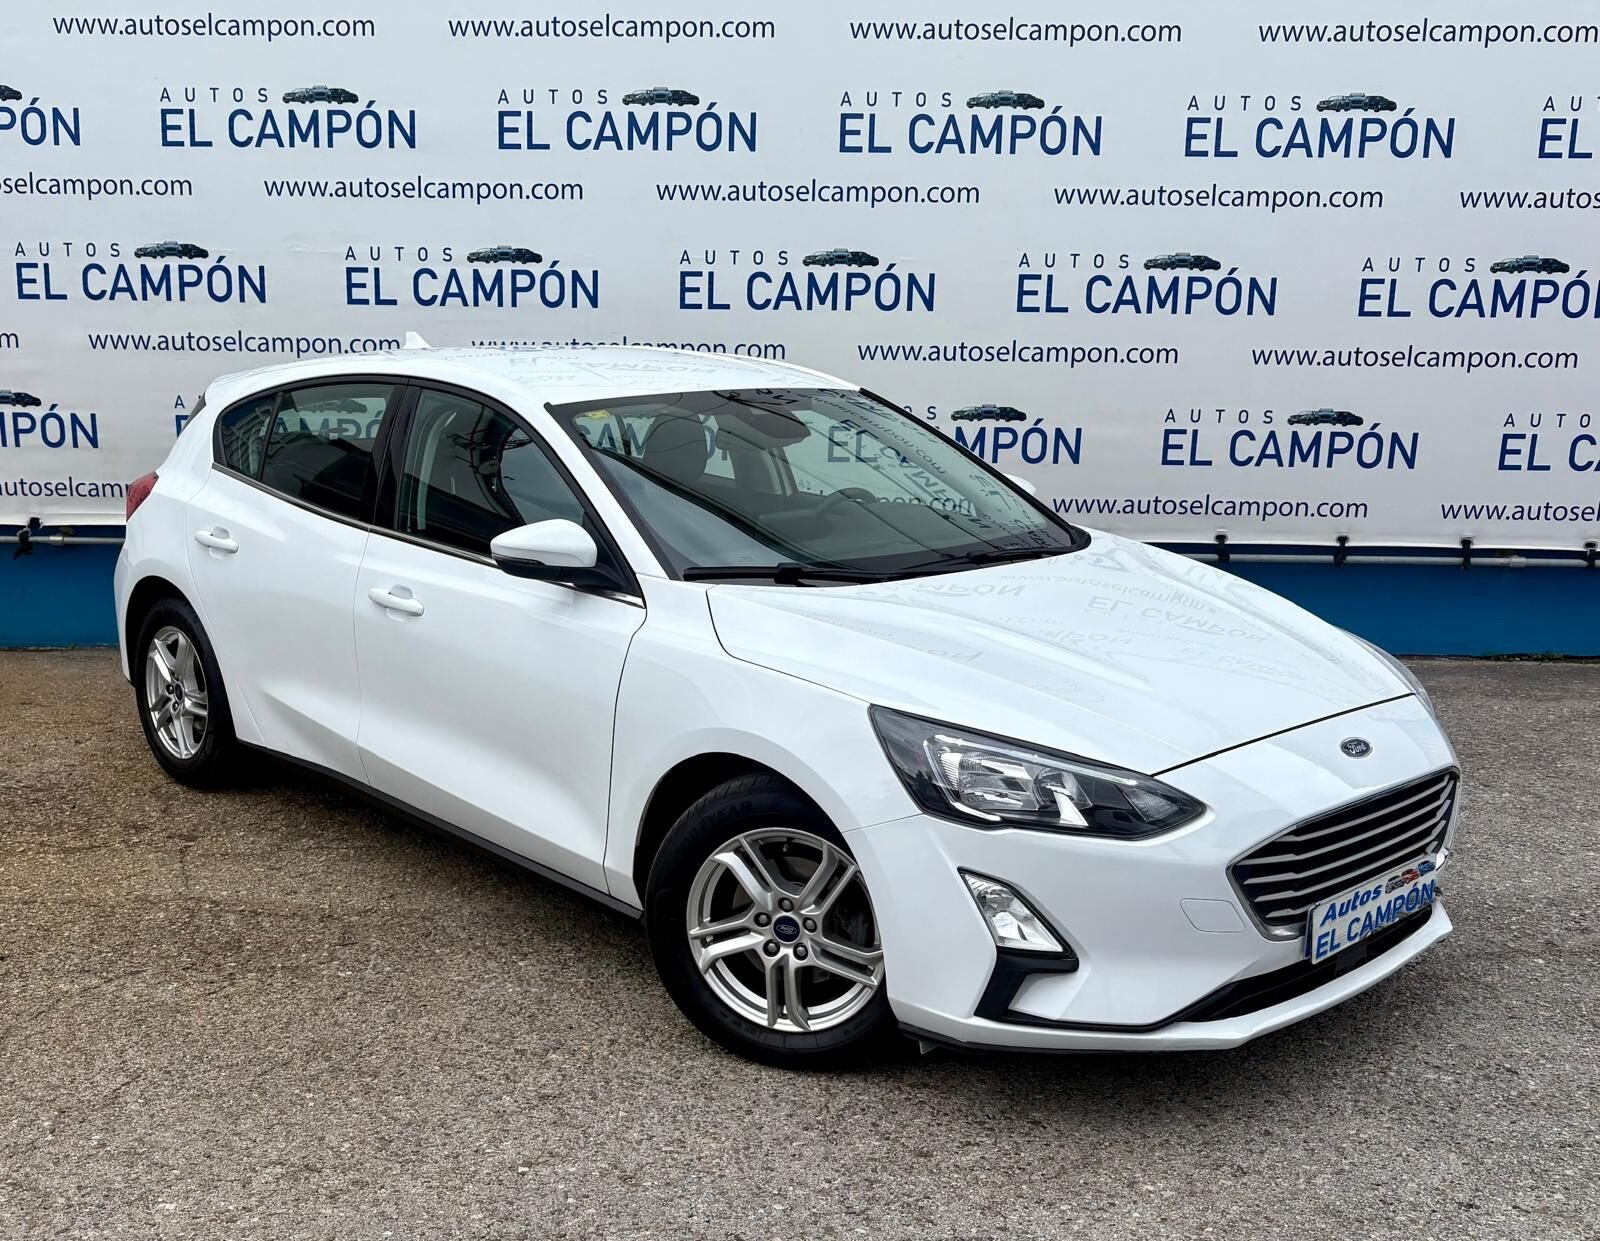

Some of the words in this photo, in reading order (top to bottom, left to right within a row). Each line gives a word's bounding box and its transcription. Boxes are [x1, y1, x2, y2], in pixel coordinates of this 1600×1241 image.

[53, 12, 374, 42] www.autoselcampon.com
[448, 13, 774, 43] www.autoselcampon.com
[850, 17, 1181, 47] www.autoselcampon.com
[1259, 18, 1598, 48] www.autoselcampon.com
[160, 87, 268, 102] AUTOS
[498, 89, 607, 104] AUTOS
[840, 91, 951, 107] AUTOS
[1187, 95, 1301, 111] AUTOS
[1543, 96, 1600, 111] AU
[161, 108, 213, 147] EL
[228, 99, 416, 149] CAMPÓN
[498, 111, 550, 150] EL
[567, 101, 756, 152] CAMPÓN
[839, 113, 892, 153] EL
[909, 104, 1102, 156] CAMPÓN
[1185, 117, 1238, 157] EL
[1256, 107, 1455, 158] CAMPÓN
[1538, 118, 1592, 159] EL
[0, 172, 192, 200] selcampon.com
[264, 176, 583, 205] www.autoselcampon.com
[656, 179, 979, 208] www.autoselcampon.com
[1054, 184, 1383, 213] www.autoselcampon.com
[15, 242, 120, 257] AUTOS
[345, 246, 452, 262] AUTOS
[680, 250, 788, 265] AUTOS
[1019, 253, 1129, 269] AUTOS
[16, 263, 68, 300] EL
[82, 255, 266, 303] CAMPÓN
[1362, 257, 1475, 272] AUTOS
[346, 267, 398, 306] EL
[413, 259, 598, 308] CAMPÓN
[680, 271, 730, 310] EL
[747, 262, 935, 311] CAMPÓN
[1017, 274, 1068, 313] EL
[1086, 266, 1277, 316] CAMPÓN
[1358, 278, 1411, 317] EL
[1429, 269, 1600, 318] CAMPÓ
[88, 330, 400, 358] www.autoselcampon.com
[858, 340, 1178, 368] www.autoselcampon.com
[1252, 345, 1578, 373] www.autoselcampon.com
[0, 403, 99, 449] PÓN
[1165, 409, 1273, 424] AUTOS
[954, 418, 1083, 465] MPÓN
[1161, 429, 1212, 466] EL
[1230, 422, 1419, 469] CAMPÓN
[1498, 434, 1551, 471] EL
[0, 476, 128, 498] utoselcam
[1052, 494, 1368, 521] www.autoselcampon.com
[1315, 928, 1341, 960] EL
[1346, 879, 1435, 942] CAMPÓN
[1320, 884, 1384, 928] Autos
